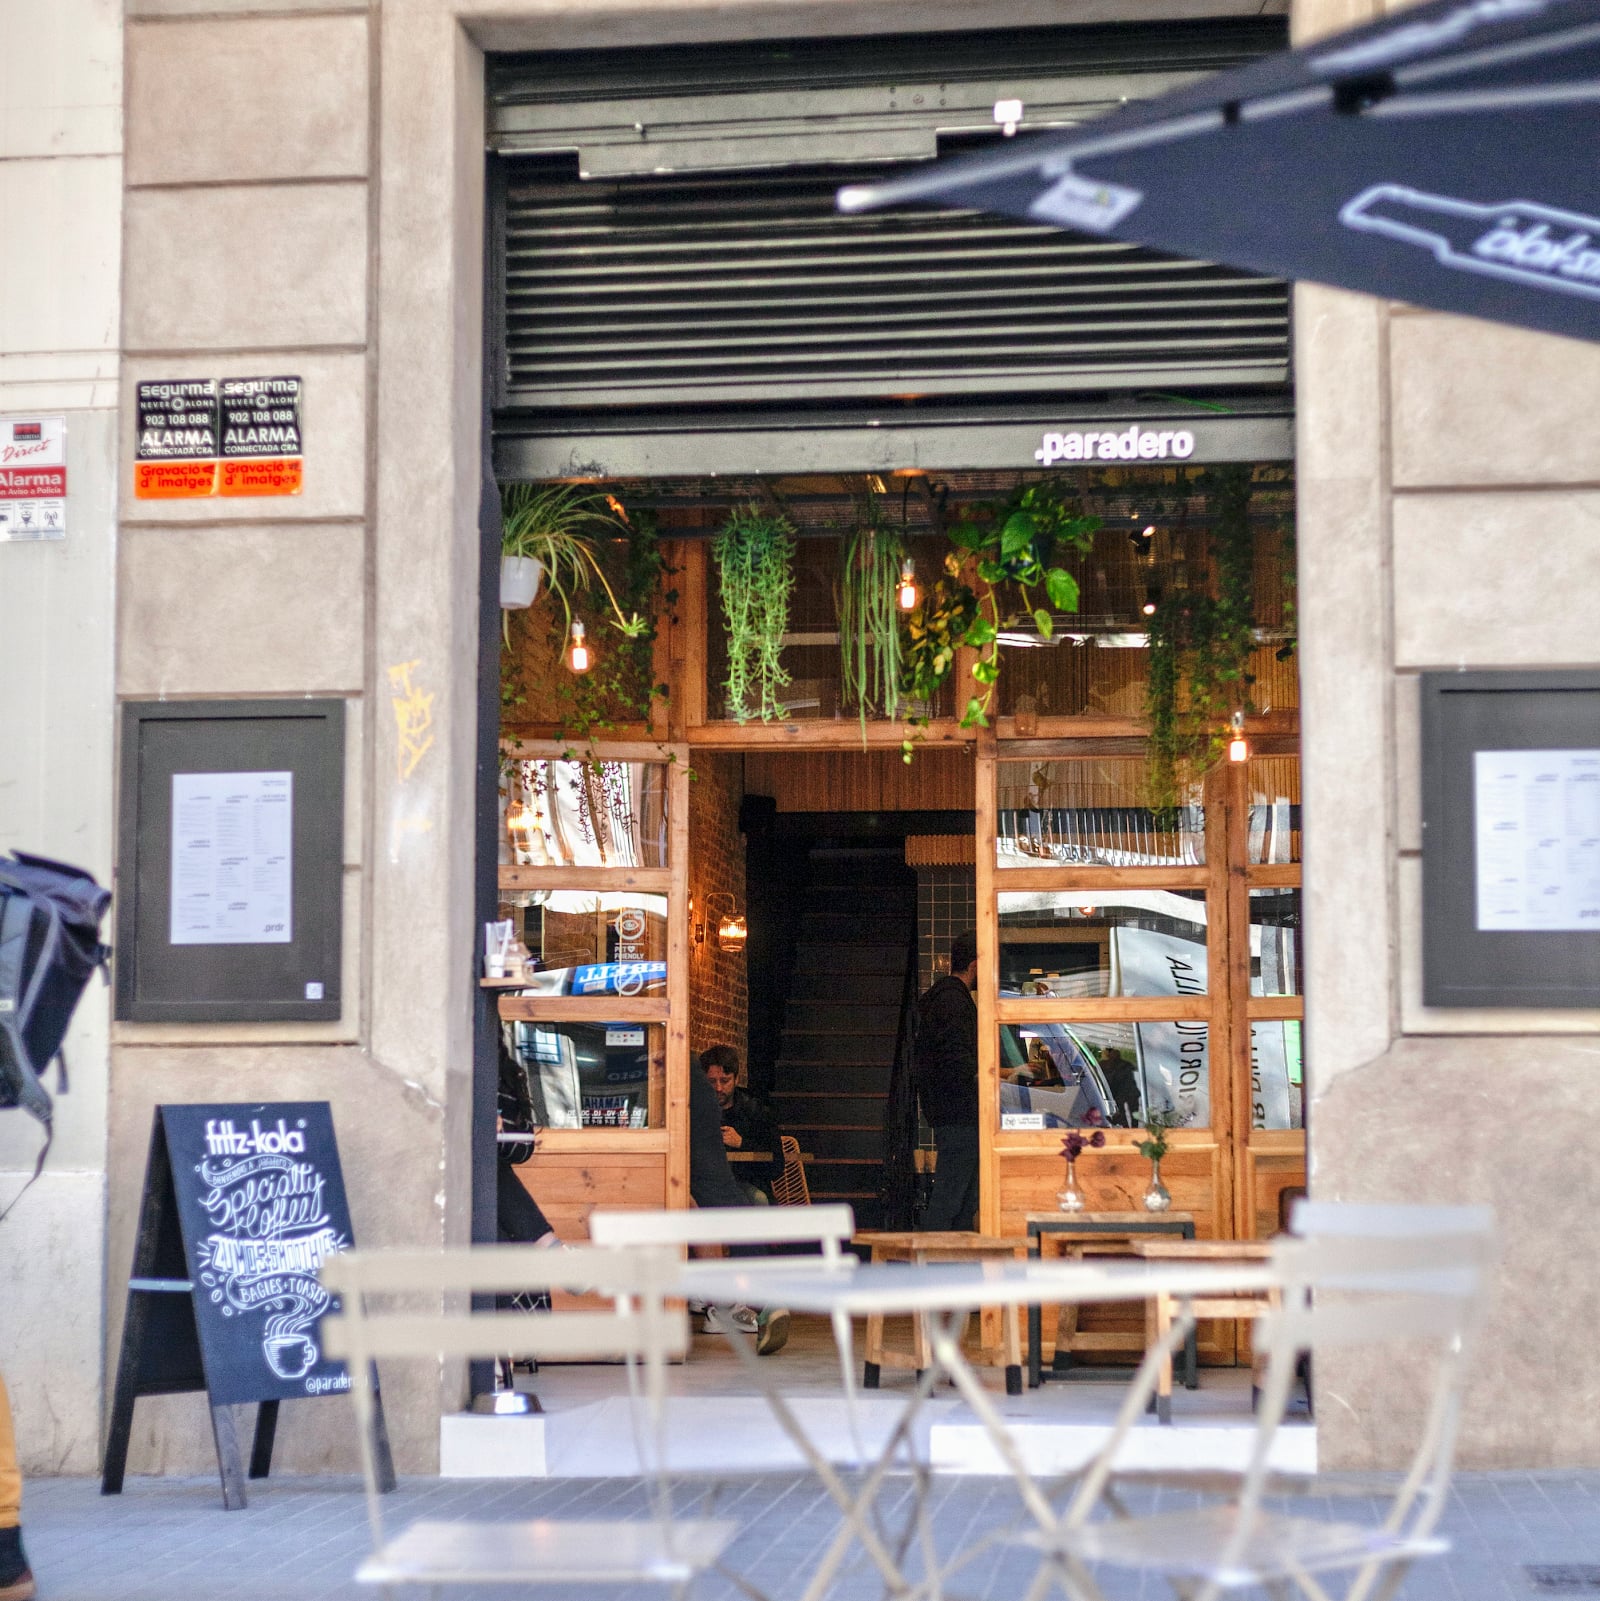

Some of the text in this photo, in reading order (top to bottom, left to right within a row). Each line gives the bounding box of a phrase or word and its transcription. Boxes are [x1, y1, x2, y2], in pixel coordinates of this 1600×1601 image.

[140, 384, 215, 399] segurma
[224, 380, 298, 396] segurma
[140, 400, 214, 409] NEVER ALONE
[224, 398, 254, 406] NEVER
[145, 413, 209, 425] 902 108 088
[229, 410, 293, 423] 902 108 088
[140, 429, 213, 447] ALARMA
[224, 426, 297, 444] ALARMA
[2, 439, 54, 463] Direct
[140, 446, 214, 456] CONNECTADA CRA
[224, 443, 298, 453] CONNECTADA CRA
[1034, 425, 1194, 466] .paradero
[140, 464, 200, 477] Gravació
[224, 462, 285, 474] Gravació
[157, 476, 212, 489] imatges
[242, 473, 297, 487] imatges
[206, 1119, 304, 1155] fritz-kola
[198, 1163, 326, 1226] Specialty
[289, 1277, 326, 1305] TOASTS
